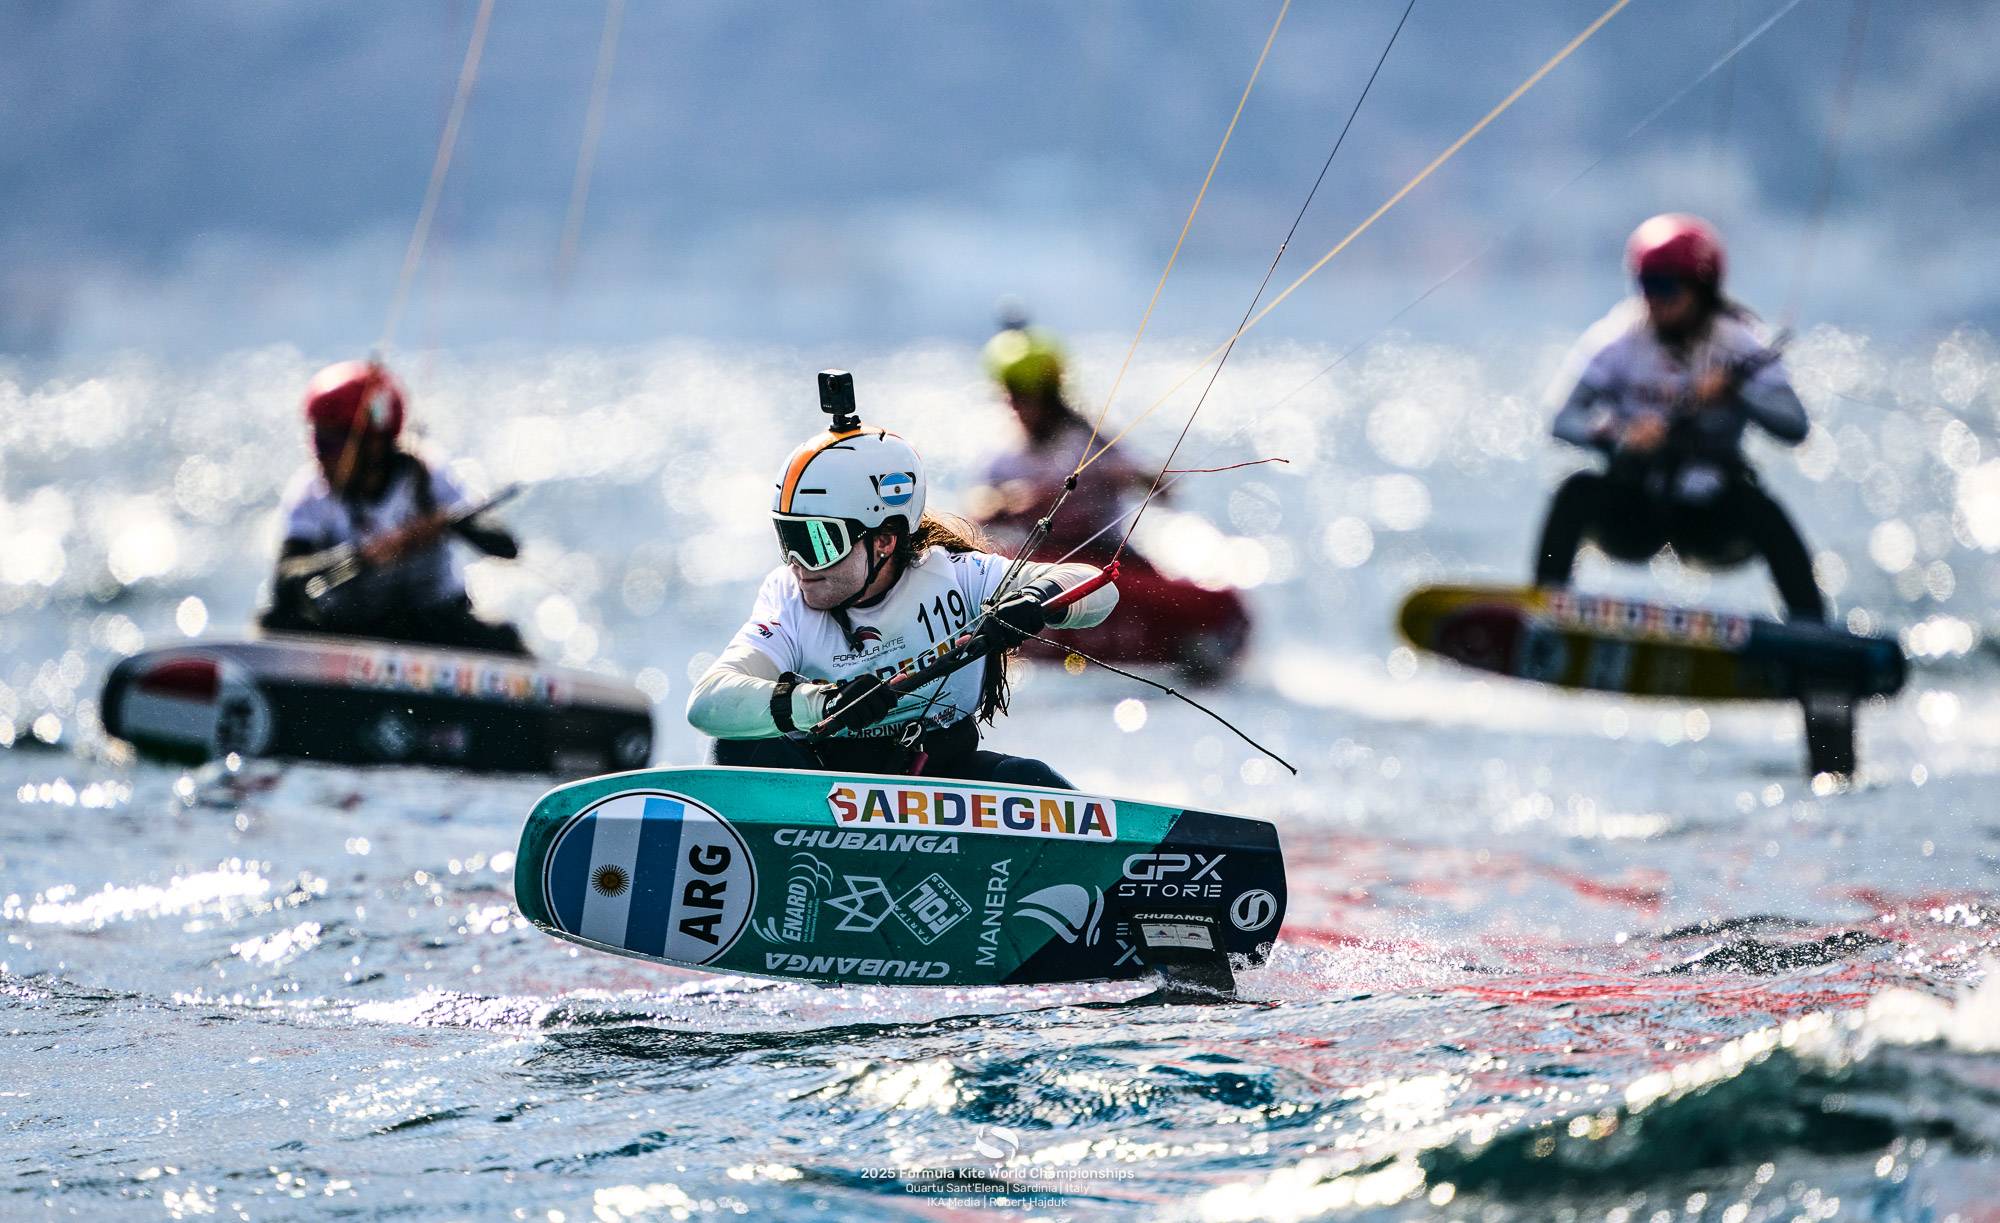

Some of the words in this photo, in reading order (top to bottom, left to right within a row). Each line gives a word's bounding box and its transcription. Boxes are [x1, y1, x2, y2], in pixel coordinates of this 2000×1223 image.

[917, 589, 967, 643] 119
[832, 646, 880, 662] FORMULA
[881, 636, 904, 651] KITE
[828, 787, 1112, 838] SARDEGNA
[773, 828, 959, 854] CHUBANGA
[1122, 853, 1227, 881] GPX
[678, 843, 732, 946] ARG
[931, 876, 969, 913] BOARDS
[1118, 884, 1222, 898] STORE
[781, 883, 808, 942] ENARD
[894, 904, 930, 942] TARIFA
[975, 858, 1012, 967] MANERA
[1133, 913, 1215, 924] CHUBANGA
[764, 952, 950, 979] CHUBANGA
